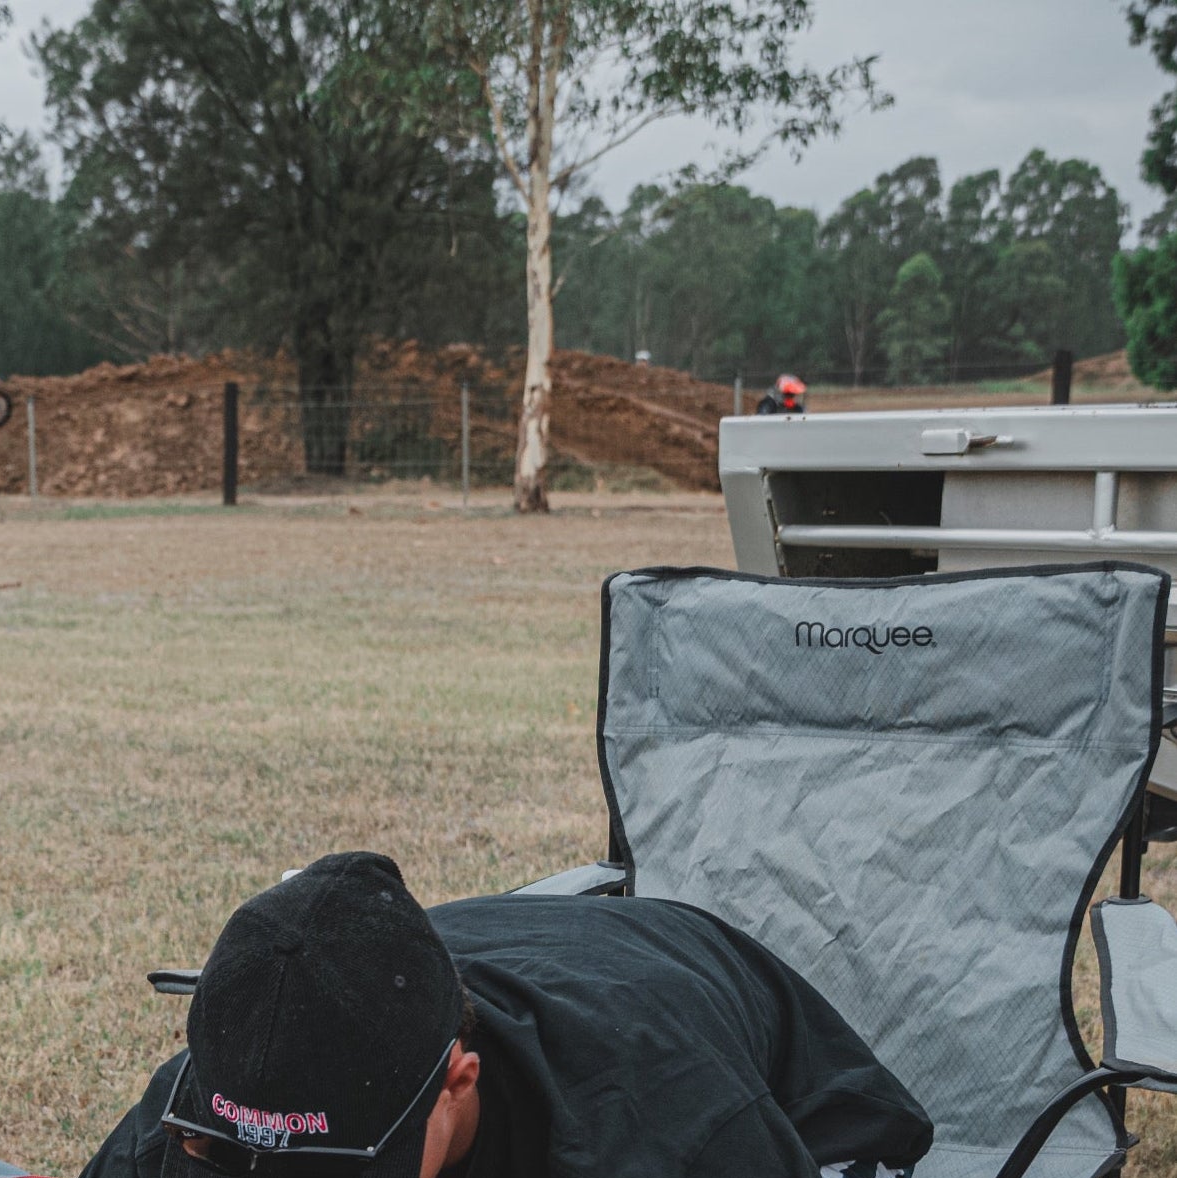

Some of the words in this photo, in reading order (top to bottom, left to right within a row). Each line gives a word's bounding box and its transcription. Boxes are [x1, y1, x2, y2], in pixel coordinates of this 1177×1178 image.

[795, 621, 933, 655] Marquee
[212, 1093, 329, 1134] COMMON
[236, 1119, 292, 1148] 1997
